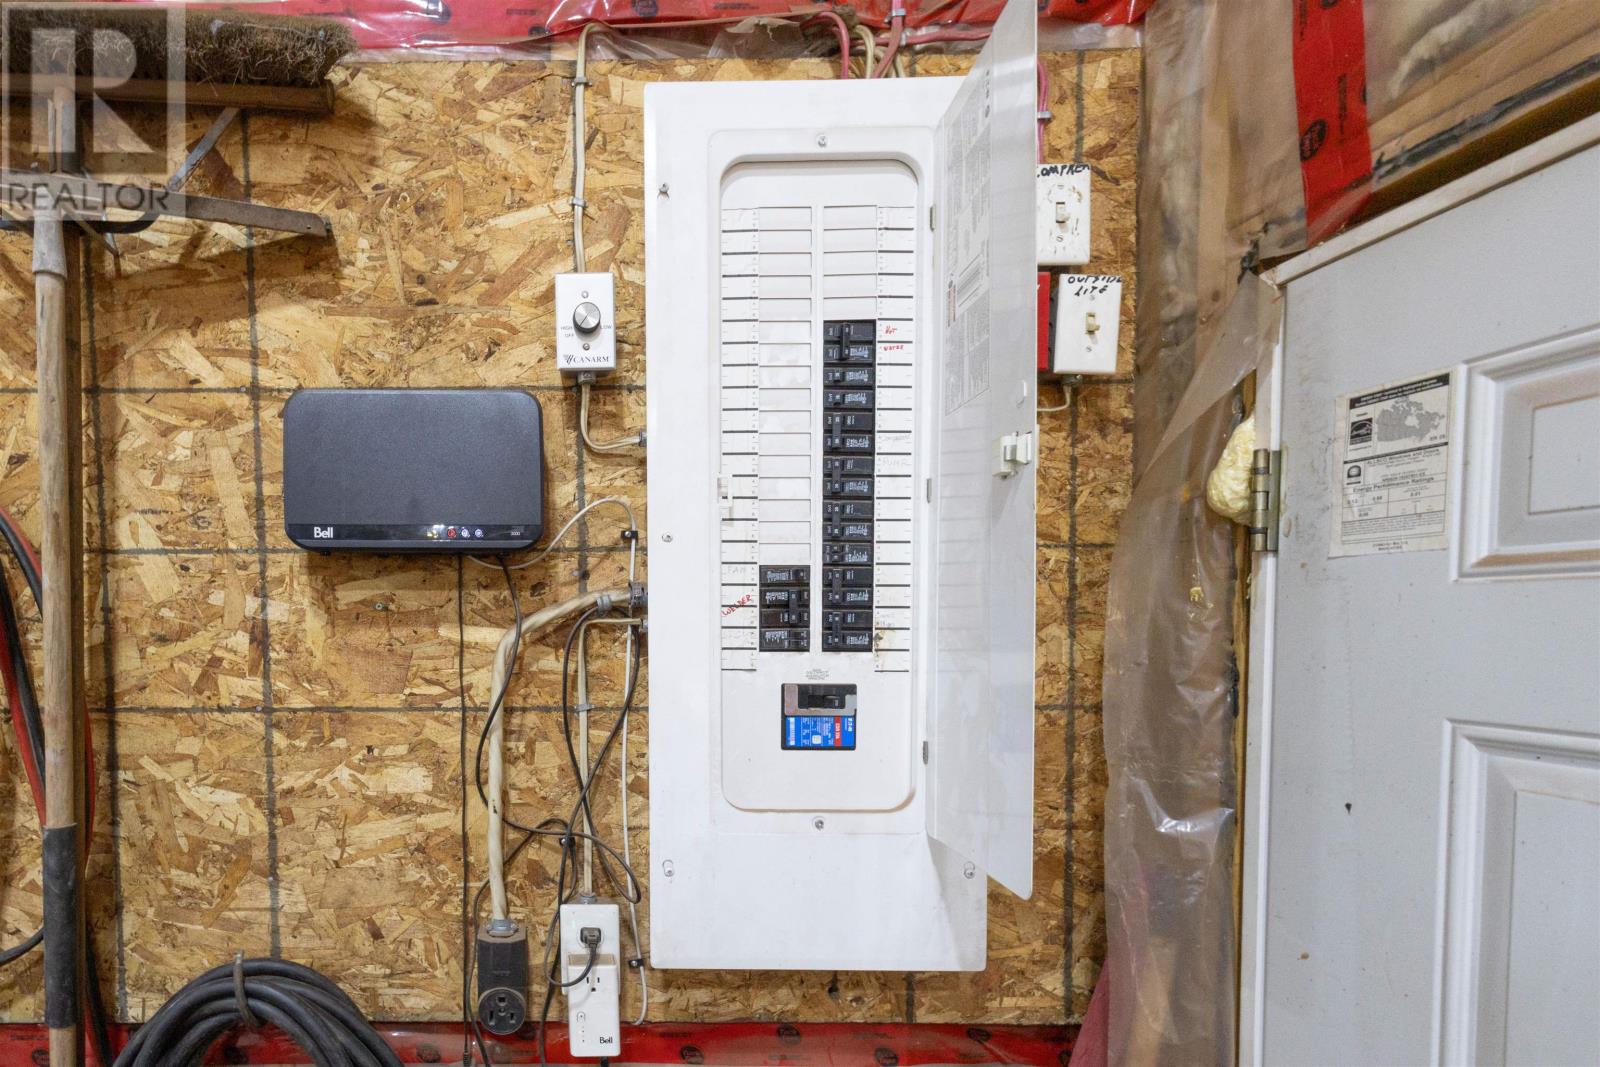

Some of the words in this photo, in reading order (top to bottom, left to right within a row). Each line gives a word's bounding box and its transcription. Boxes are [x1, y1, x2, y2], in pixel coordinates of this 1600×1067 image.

[1074, 285, 1108, 297] LITE
[573, 355, 609, 363] CANARM
[1352, 486, 1373, 494] Energy
[1373, 481, 1410, 490] Performance
[1411, 476, 1435, 485] Ratings
[313, 526, 334, 538] Bell
[599, 1036, 613, 1044] Bell
